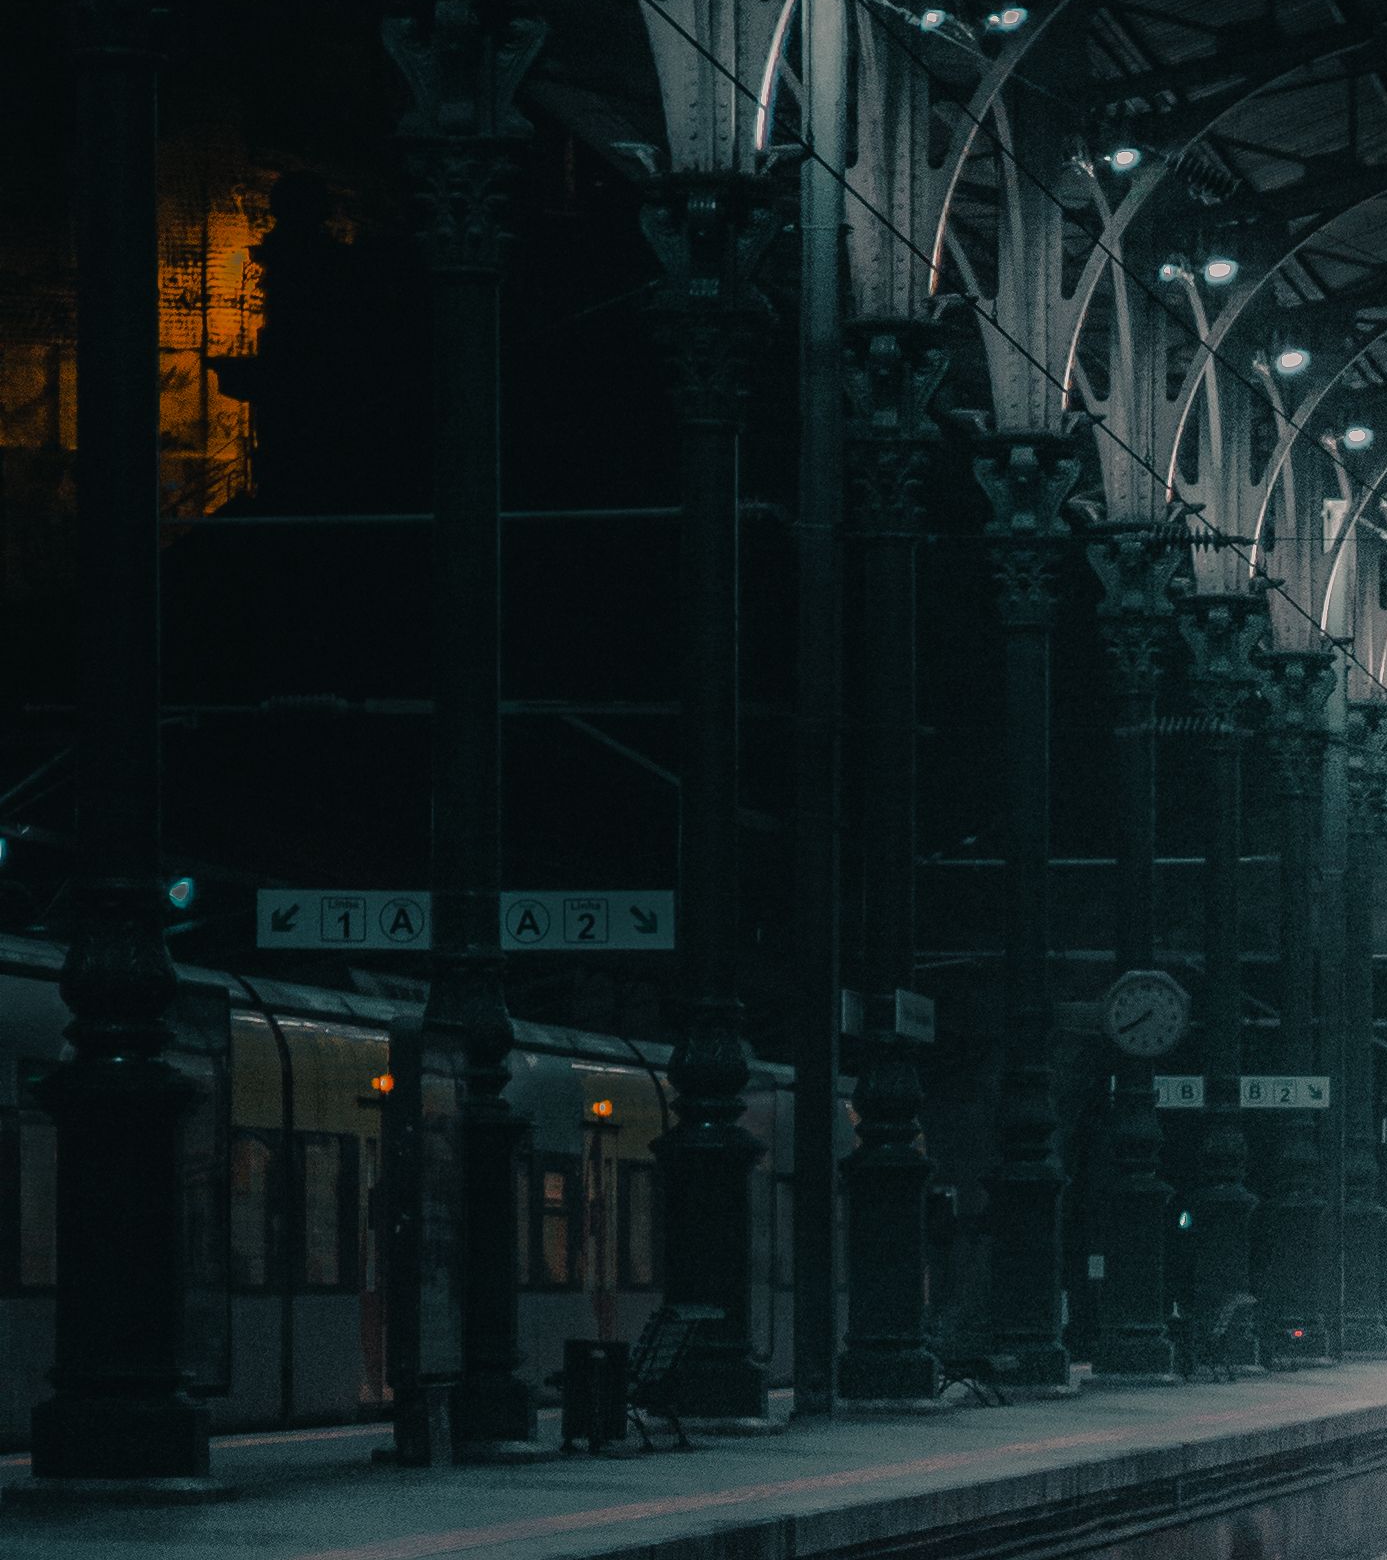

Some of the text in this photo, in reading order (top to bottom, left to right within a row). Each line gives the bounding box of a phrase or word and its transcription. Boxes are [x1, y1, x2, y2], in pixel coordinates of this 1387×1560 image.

[338, 908, 414, 938] 1 A
[516, 909, 595, 939] A 2
[1181, 1085, 1194, 1099] B
[1280, 1088, 1291, 1102] 2
